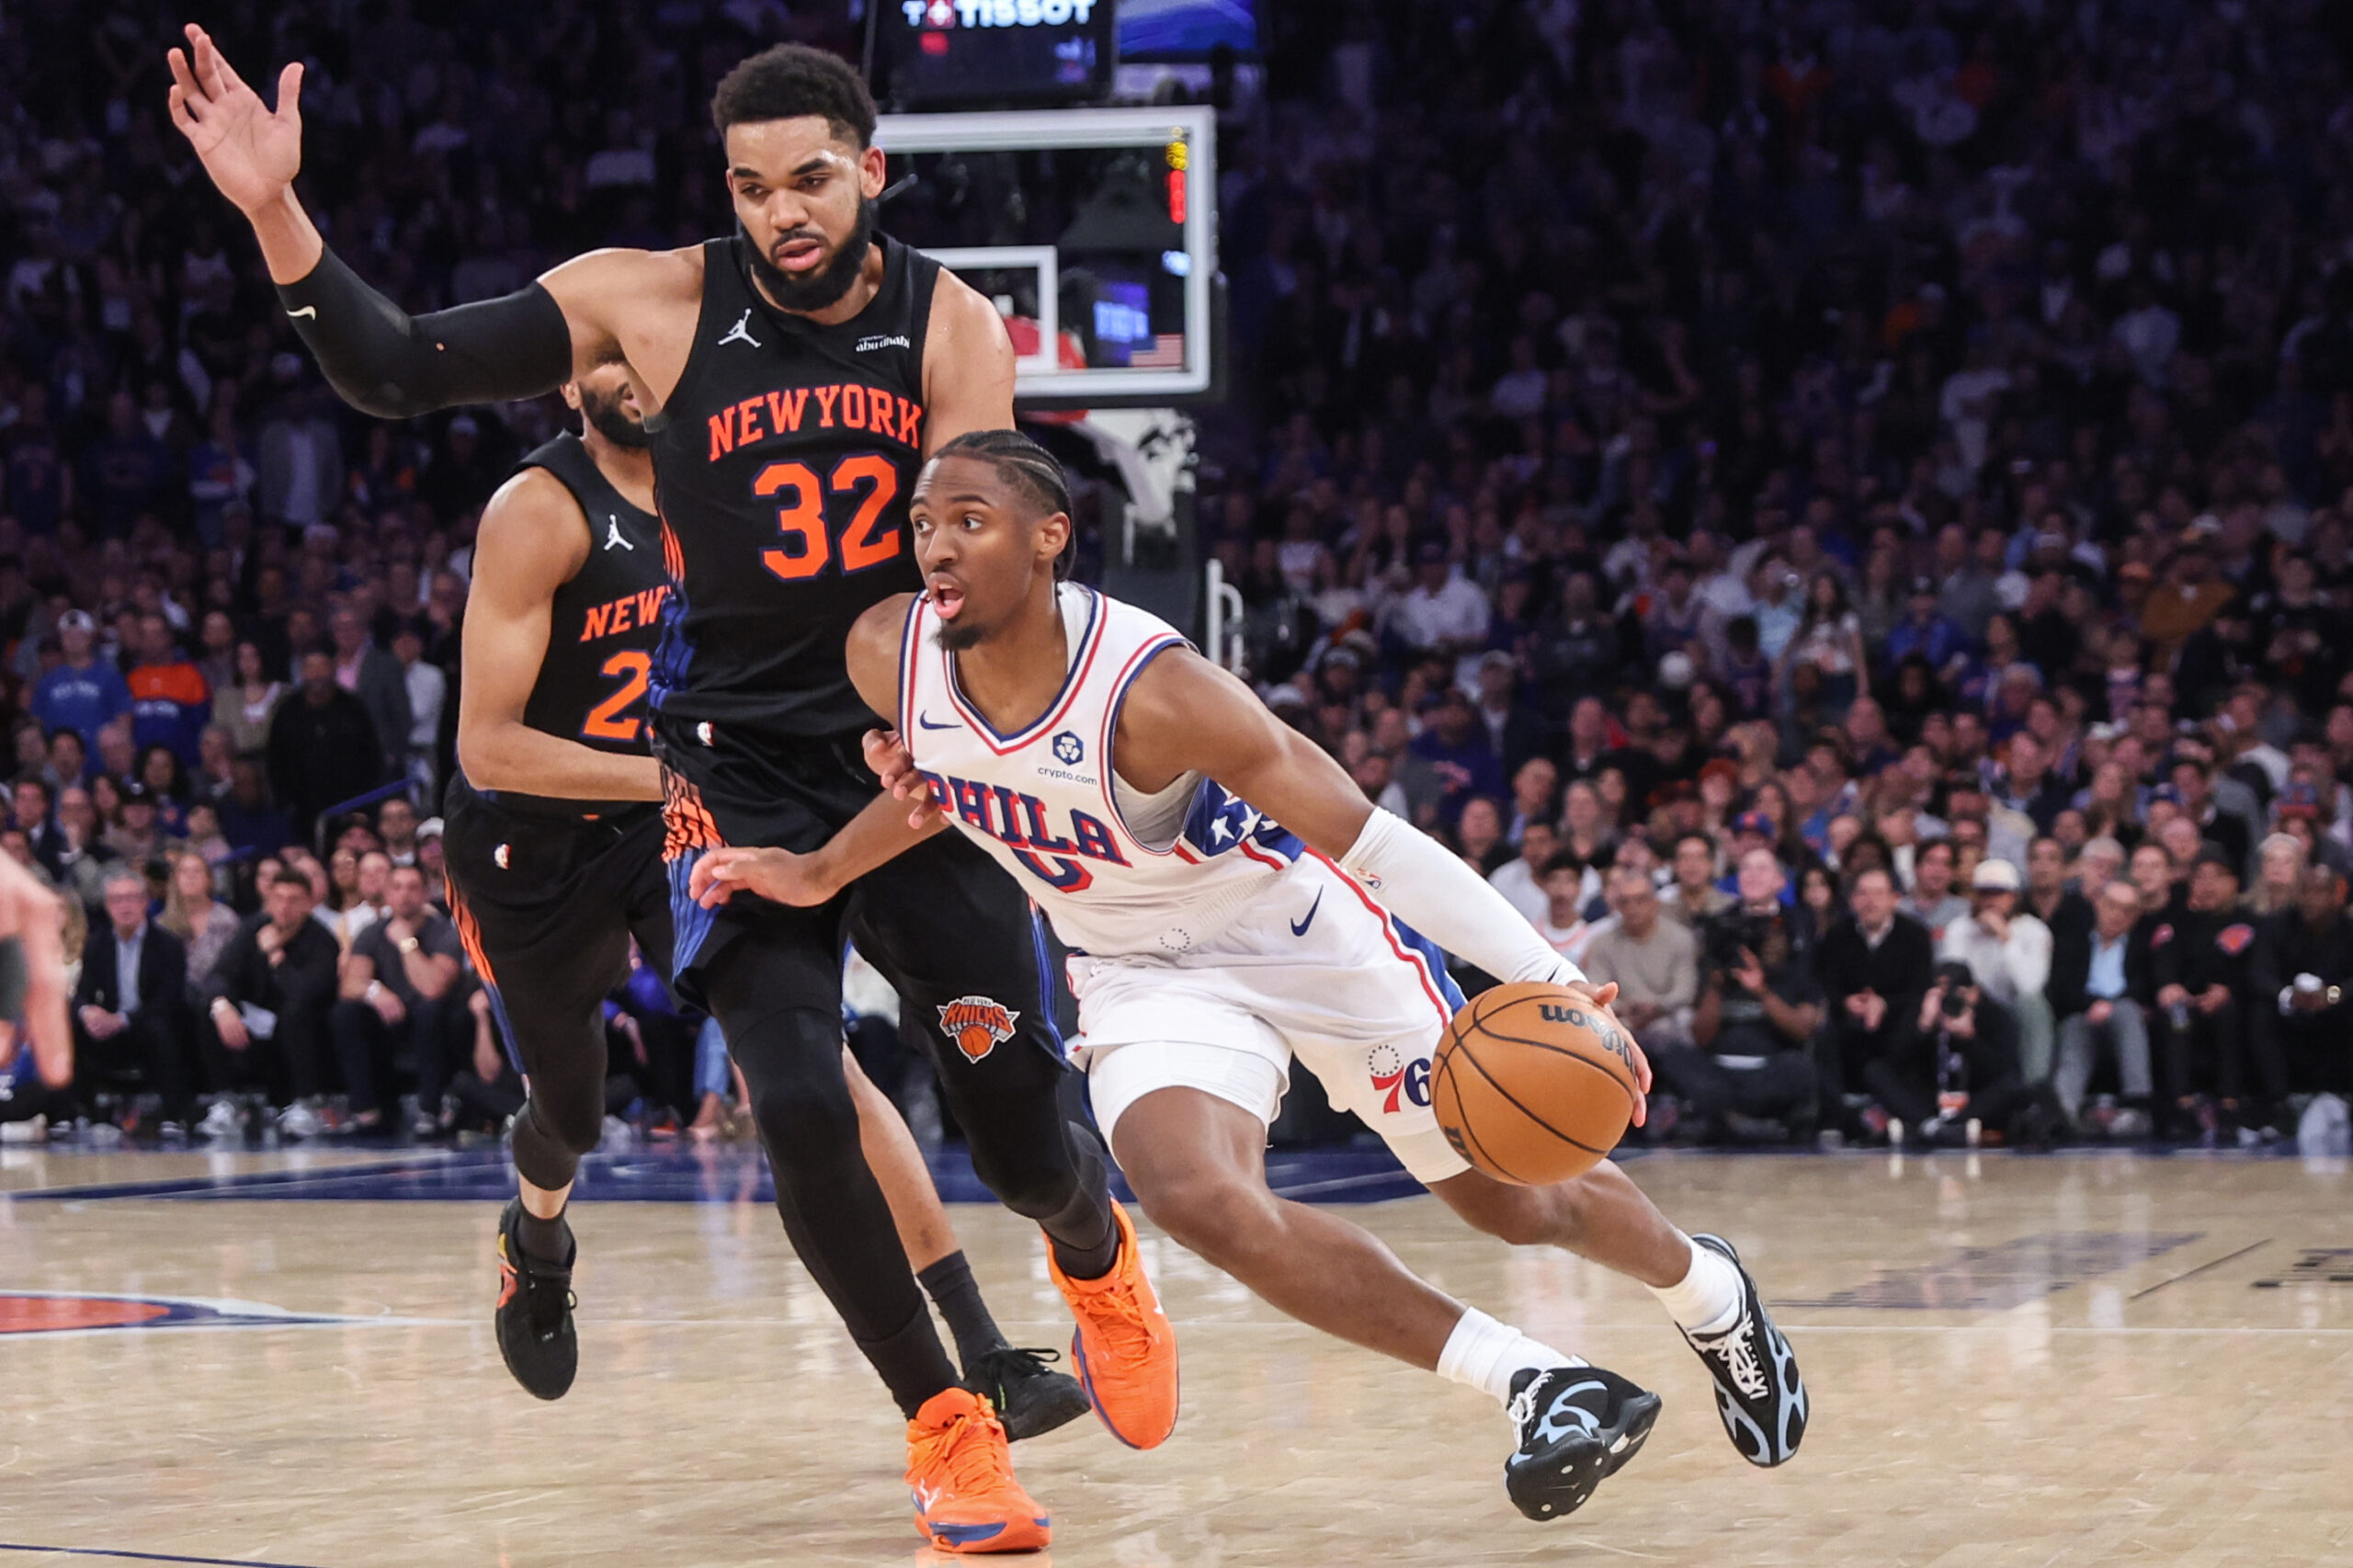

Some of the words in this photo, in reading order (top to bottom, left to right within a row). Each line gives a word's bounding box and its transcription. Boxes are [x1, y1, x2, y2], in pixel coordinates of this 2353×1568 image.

[953, 0, 1097, 28] TISSOT
[856, 341, 879, 352] abu
[708, 389, 809, 462] NEW
[814, 383, 923, 449] YORK
[751, 451, 903, 581] 32
[579, 584, 673, 642] NEW
[581, 649, 656, 743] 2
[1037, 766, 1097, 787] crypto.com
[916, 768, 1133, 869] PHILA
[942, 1002, 1012, 1033] KNICKS
[1369, 1057, 1432, 1115] 76
